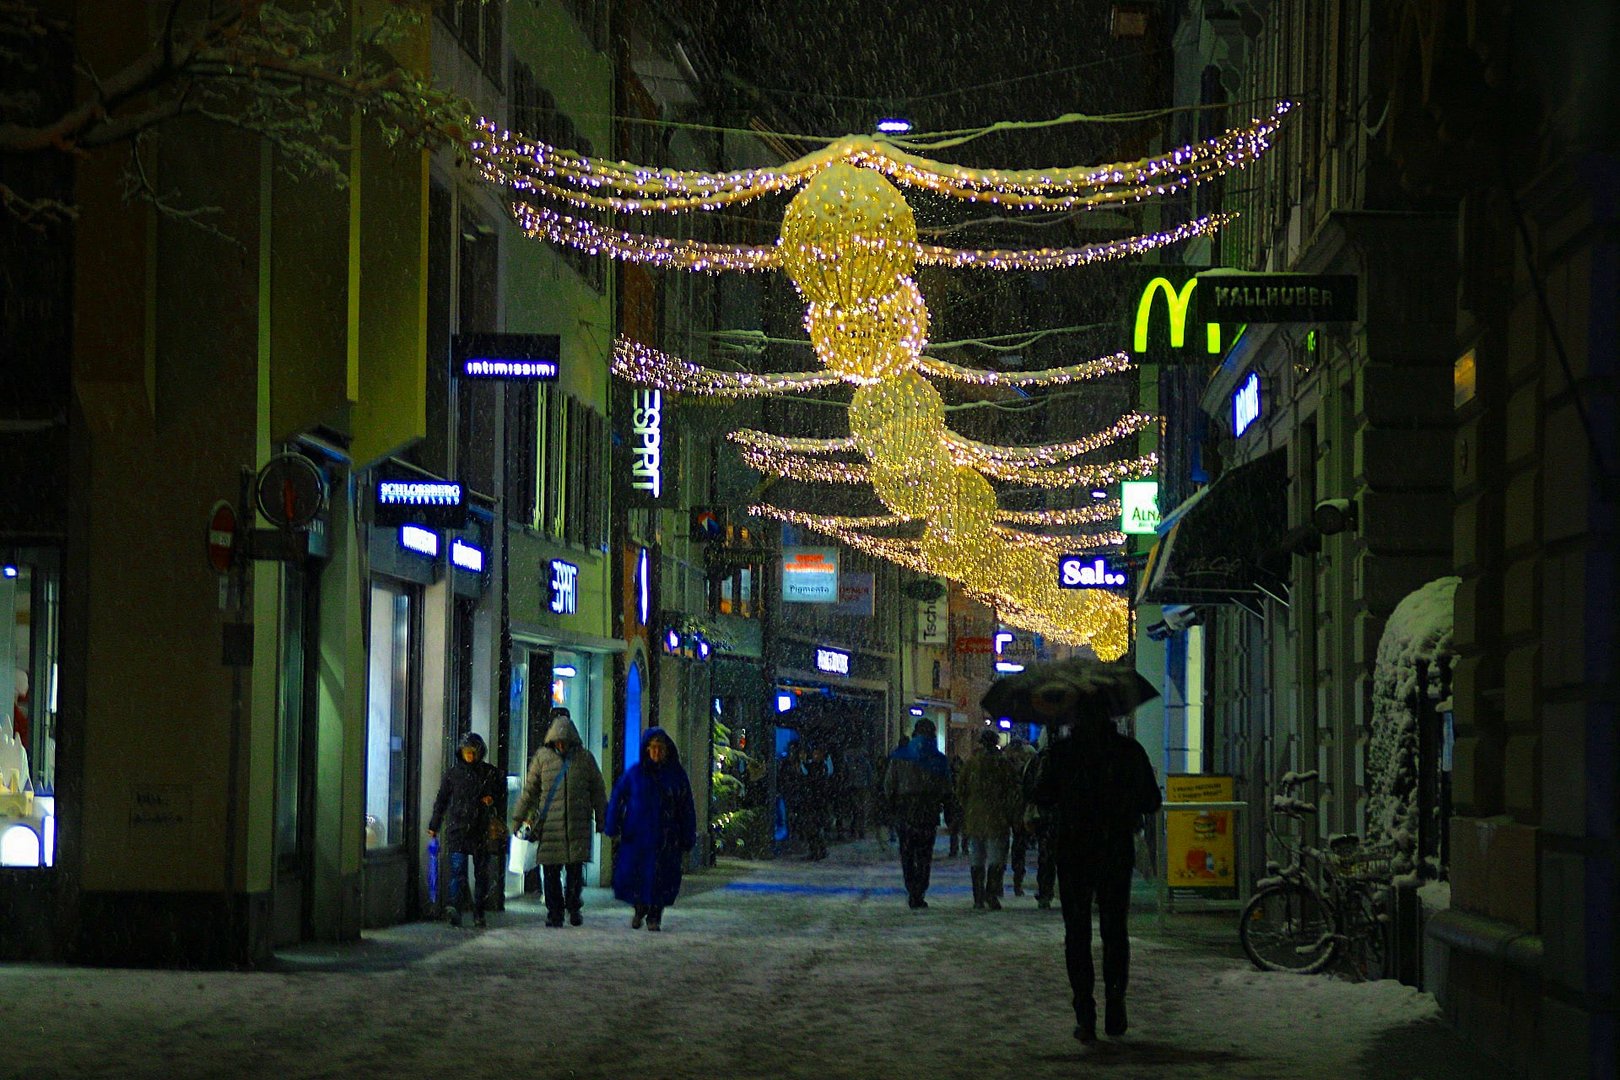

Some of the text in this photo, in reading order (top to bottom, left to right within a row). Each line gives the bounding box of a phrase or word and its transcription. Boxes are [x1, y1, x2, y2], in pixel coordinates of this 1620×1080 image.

[1214, 286, 1334, 307] MALLHUBER
[466, 360, 556, 377] intimissimi
[631, 389, 661, 499] ESPRIT
